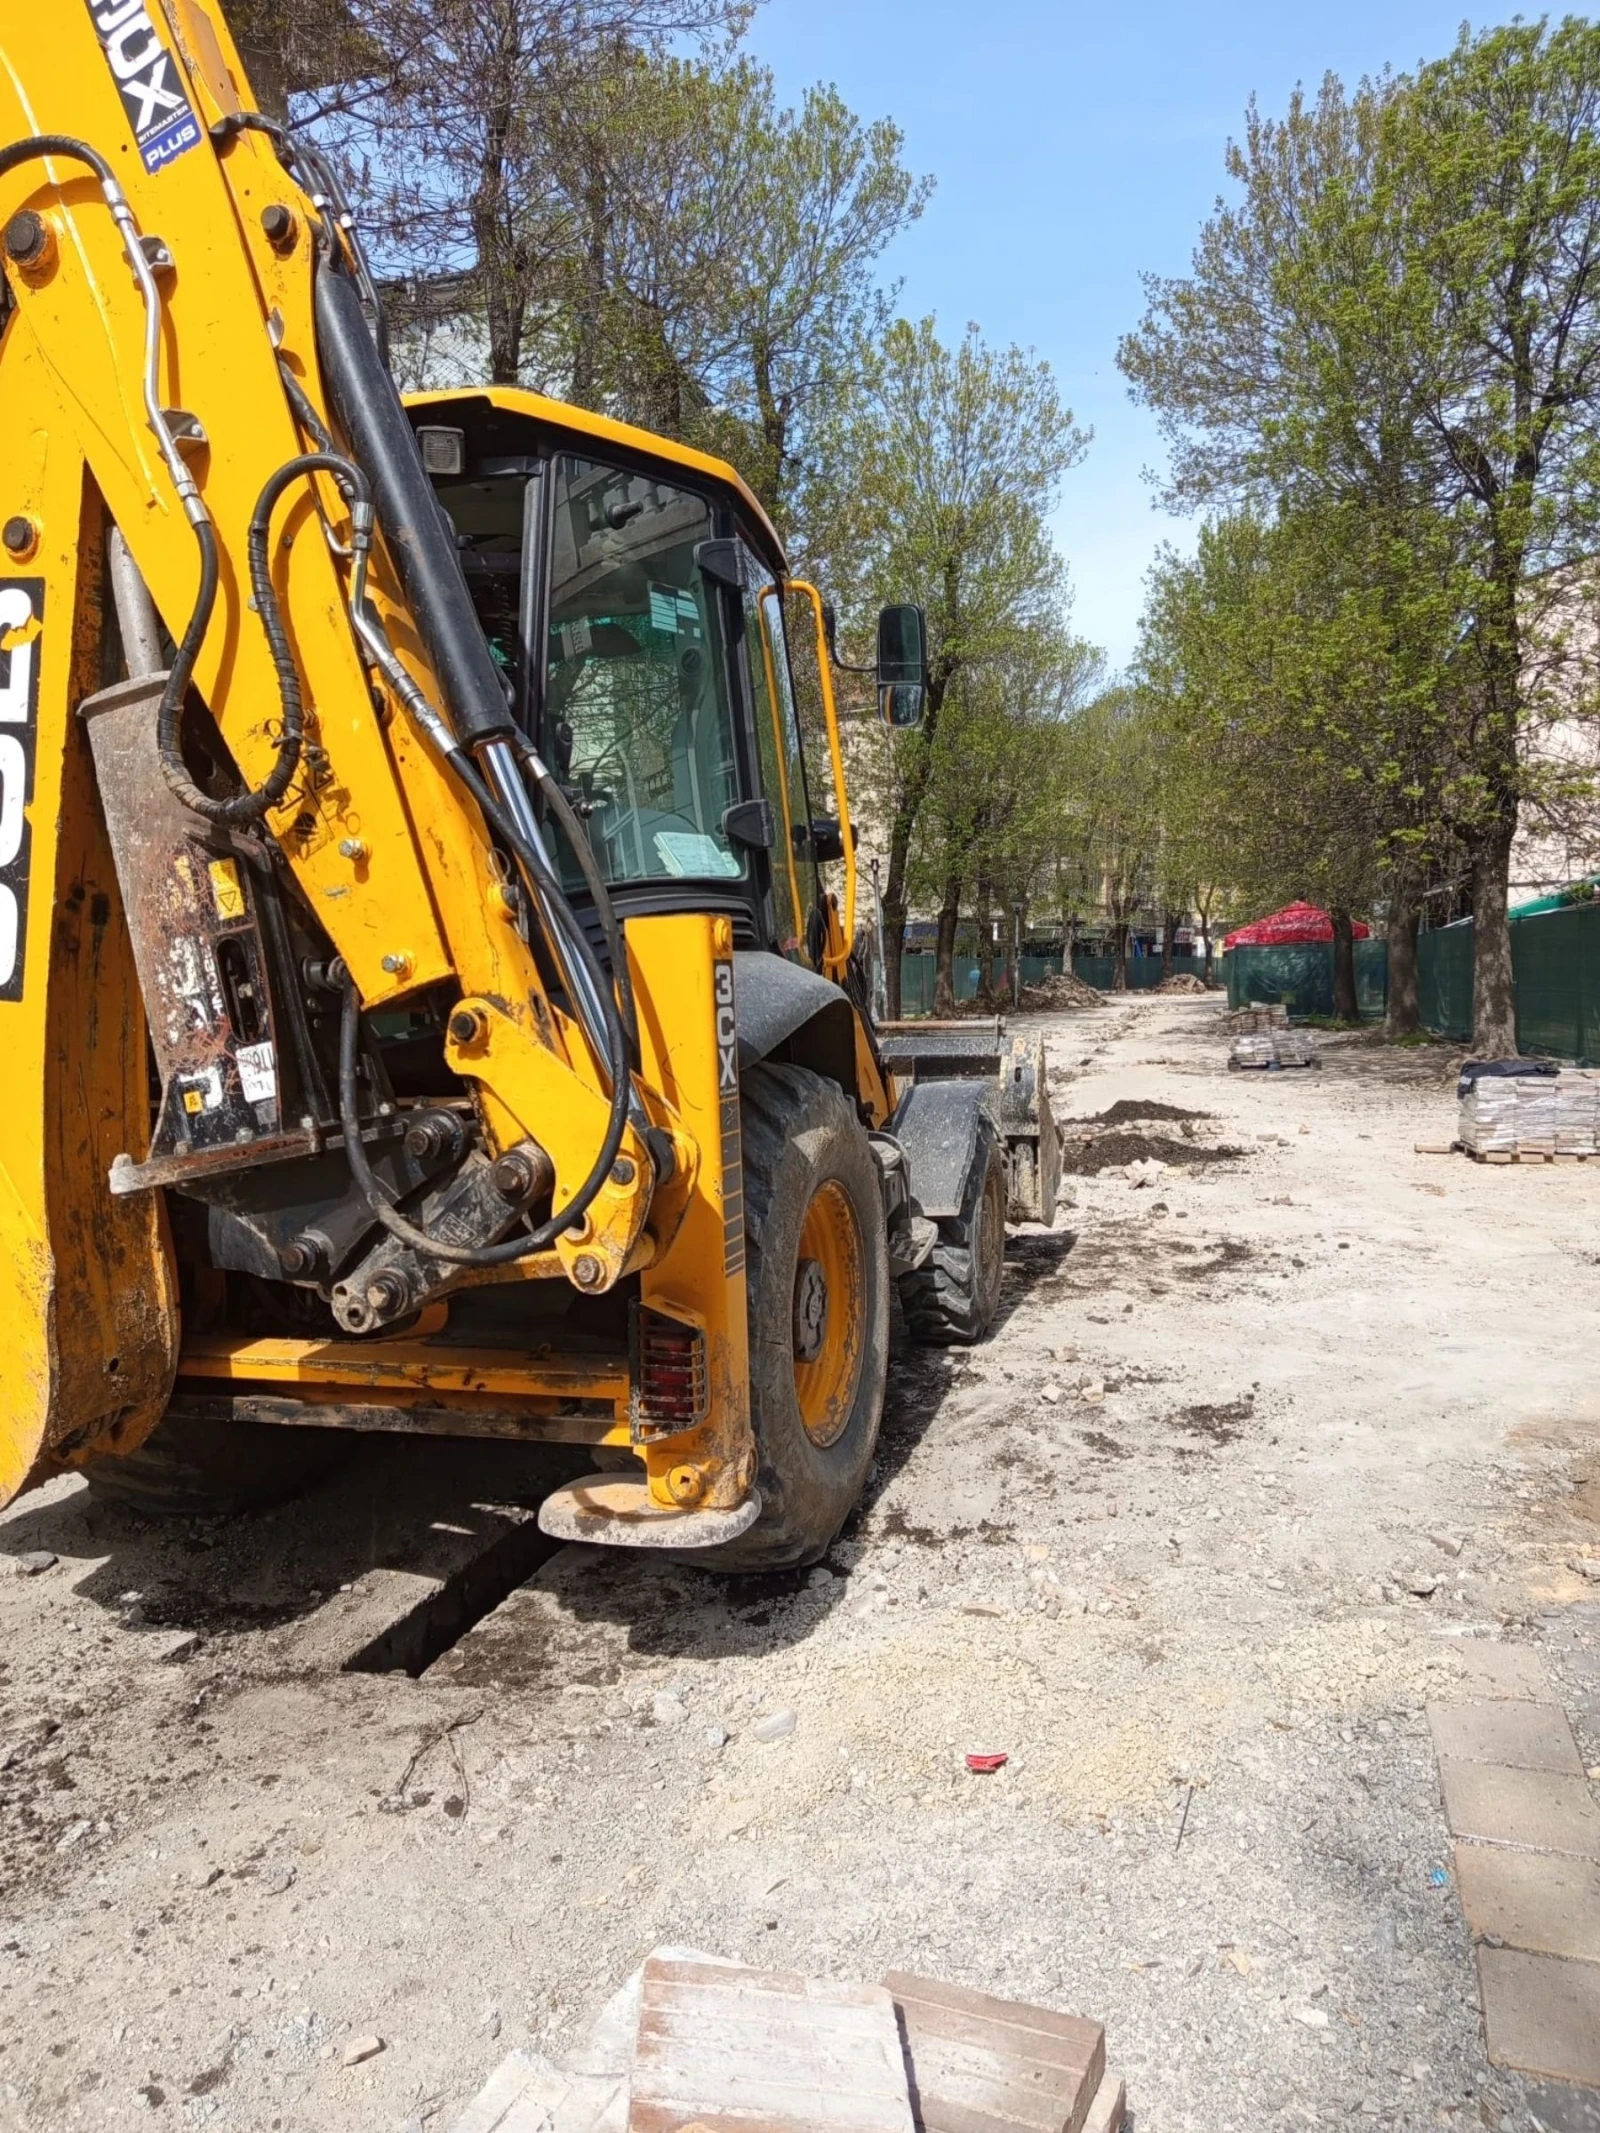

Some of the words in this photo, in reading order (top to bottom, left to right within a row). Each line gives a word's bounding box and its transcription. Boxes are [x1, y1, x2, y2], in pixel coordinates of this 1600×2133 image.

[138, 104, 189, 144] SITEMASTER
[145, 124, 196, 167] PLUS
[715, 964, 737, 1088] 3CX
